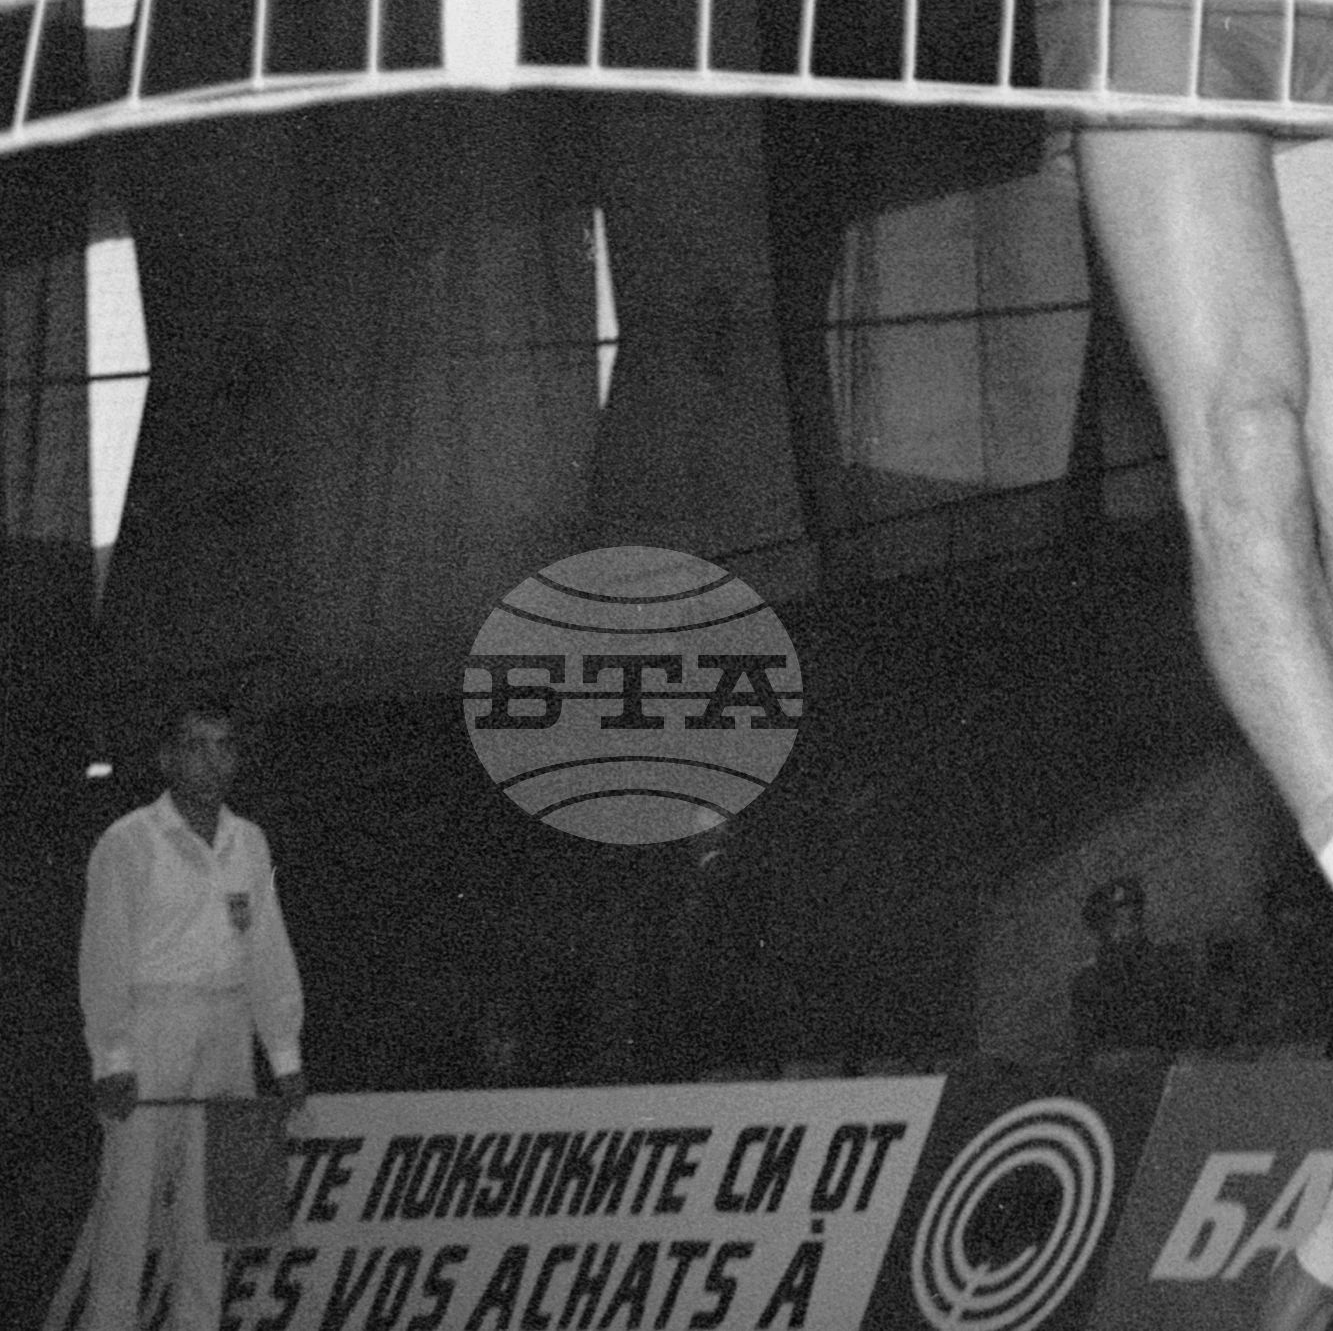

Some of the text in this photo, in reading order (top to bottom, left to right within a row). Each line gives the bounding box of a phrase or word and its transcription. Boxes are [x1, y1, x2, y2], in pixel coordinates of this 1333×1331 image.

[360, 1126, 714, 1222] ПОКУПКИТЕ
[713, 1123, 808, 1215] СИ
[811, 1121, 909, 1214] ОТ
[317, 1243, 471, 1331] VOS
[462, 1241, 755, 1331] ACHATS
